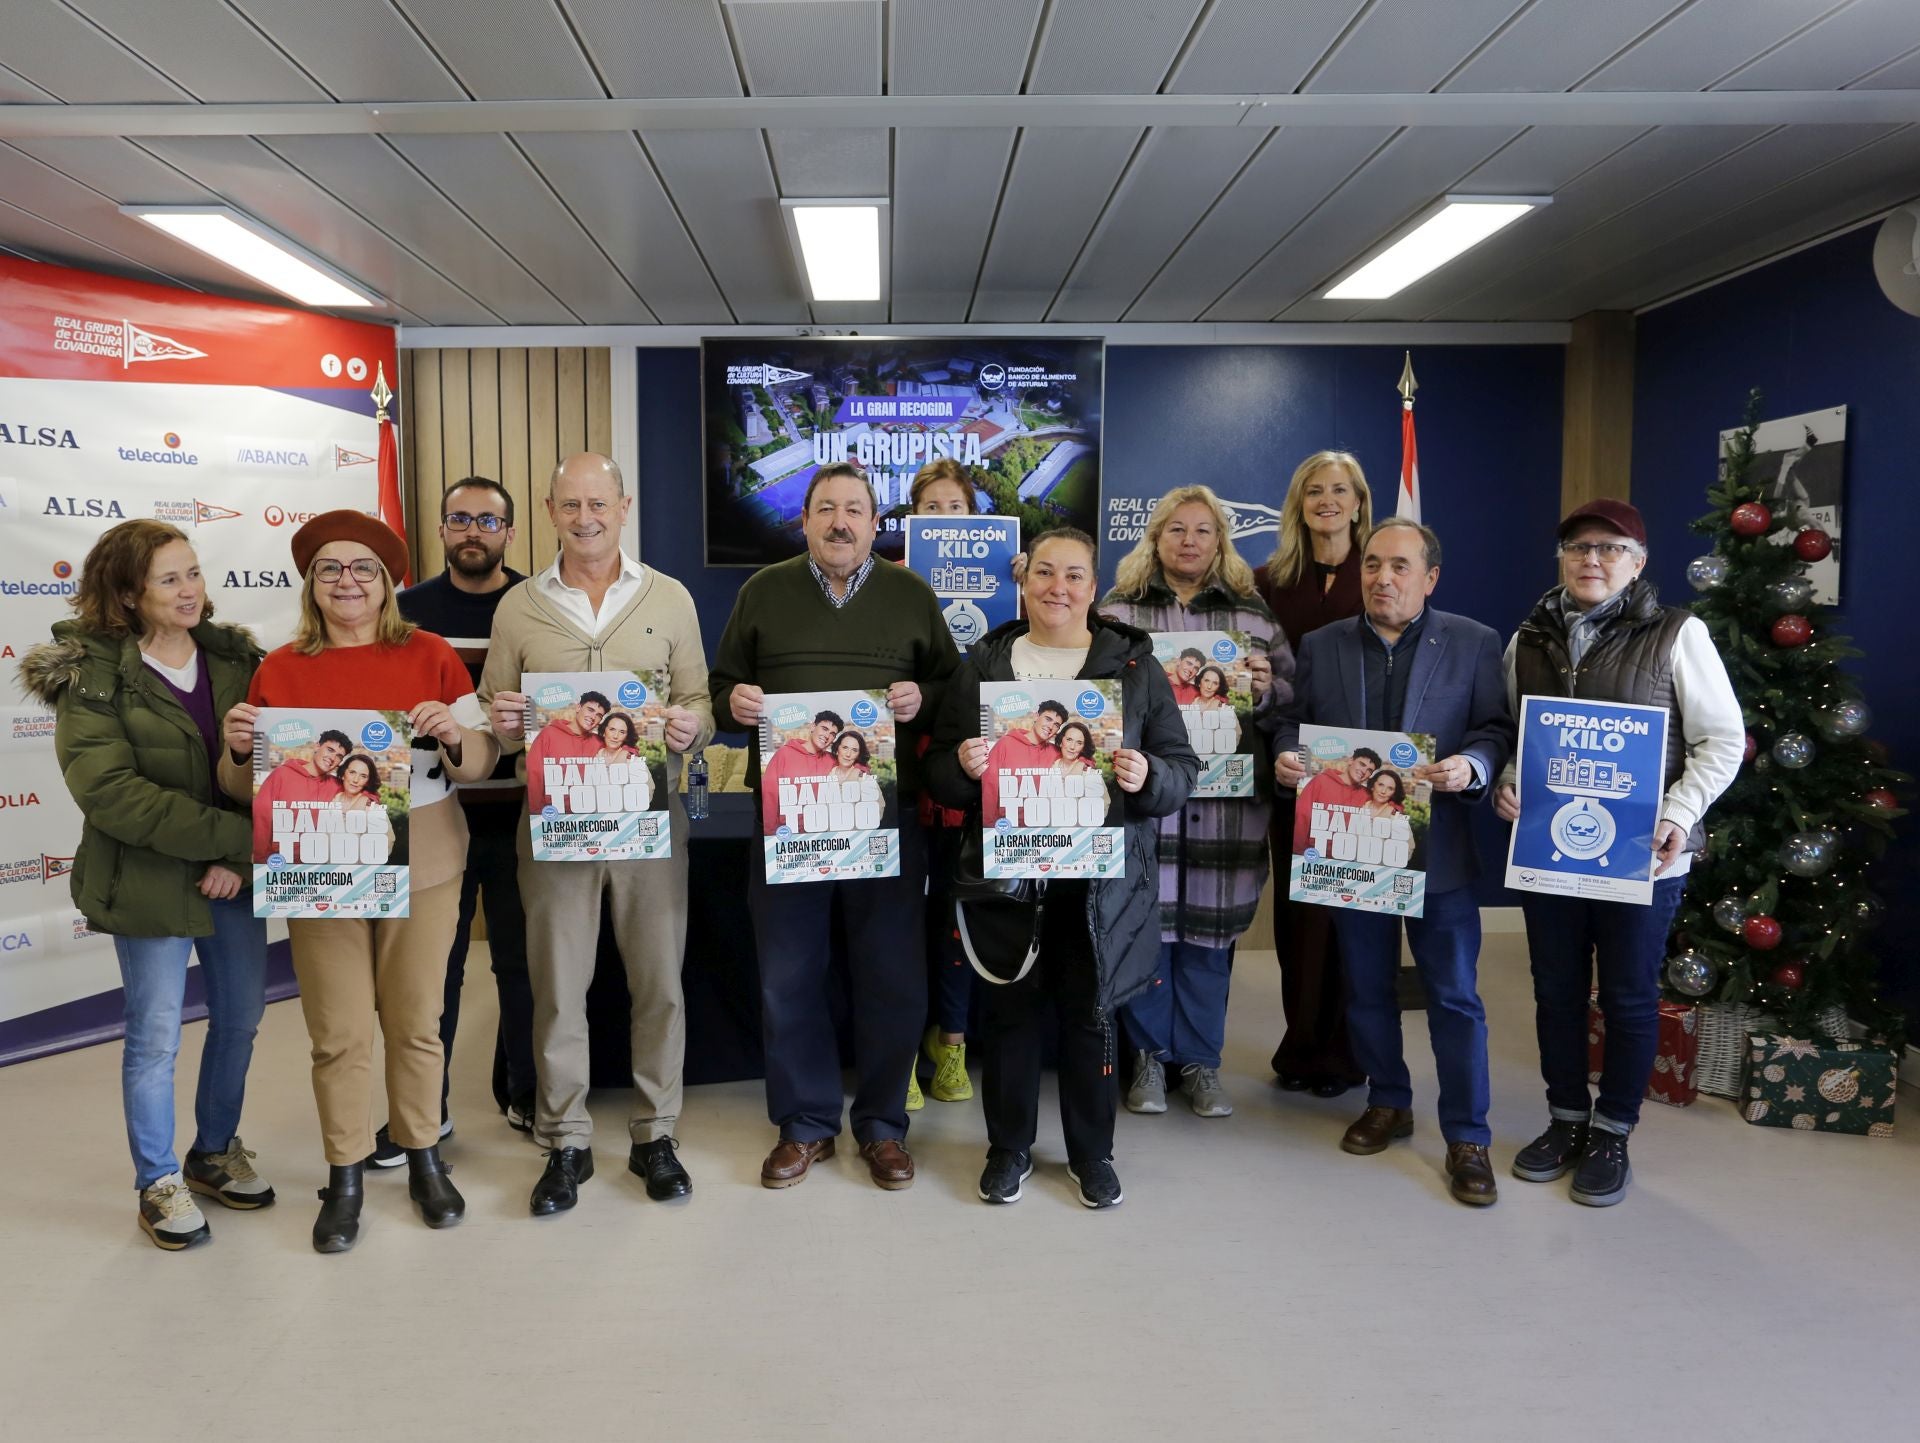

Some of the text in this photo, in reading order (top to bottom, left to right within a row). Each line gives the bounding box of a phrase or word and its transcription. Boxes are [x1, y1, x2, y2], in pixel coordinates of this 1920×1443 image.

[54, 316, 123, 336] REAL GRUPO
[56, 329, 123, 347] de CULTURA
[54, 339, 123, 358] COVADONGA
[1007, 365, 1045, 373] FUNDACIÓN
[850, 402, 953, 417] LA GRAN RECOGIDA
[0, 423, 80, 449] ALSA
[118, 447, 198, 466] telecable
[813, 432, 990, 470] UN GRUPISTA,
[868, 472, 890, 505] N
[42, 496, 126, 519] ALSA
[1108, 498, 1159, 512] REAL G
[885, 518, 897, 531] 19
[1110, 513, 1152, 527] de CU
[921, 526, 1007, 541] OPERACIÓN
[1108, 527, 1146, 541] COVA
[938, 541, 990, 559] KILO
[0, 580, 81, 595] telecabl
[222, 570, 293, 588] ALSA
[25, 722, 56, 731] CULTUR
[1540, 712, 1649, 736] OPERACIÓN
[13, 730, 55, 739] COVADONG
[1559, 728, 1626, 753] KILO
[543, 761, 649, 786] DAMOS
[1015, 767, 1062, 776] ASTURIAS
[778, 780, 880, 806] DAMOS
[999, 774, 1105, 798] DAMOS
[272, 800, 343, 809] EN ASTURIAS
[545, 783, 650, 814] TODO
[779, 801, 880, 834] TODO
[1000, 796, 1105, 827] TODO
[272, 808, 389, 834] DAMOS
[541, 819, 620, 834] LA GRAN RECOGIDA
[1311, 809, 1410, 840] DAMOS
[542, 834, 553, 842] HAZ
[775, 838, 851, 855] LA GRAN RECOGIDA
[994, 834, 1073, 848] LA GRAN RECOGIDA
[272, 832, 389, 865] TODO
[994, 849, 1005, 857] HAZ
[1006, 849, 1012, 857] TU
[1310, 829, 1409, 868] TODO
[14, 859, 40, 869] GRUPO
[776, 855, 787, 863] HAZ
[787, 854, 794, 862] TU
[0, 873, 41, 885] OVADONGA
[7, 866, 41, 877] CULTURA
[266, 872, 353, 886] LA GRAN RECOGIDA
[1300, 875, 1311, 883] HAZ
[1312, 876, 1318, 884] TU
[1301, 862, 1376, 884] LA GRAN RECOGIDA
[265, 886, 278, 895] HAZ
[279, 886, 287, 895] TU
